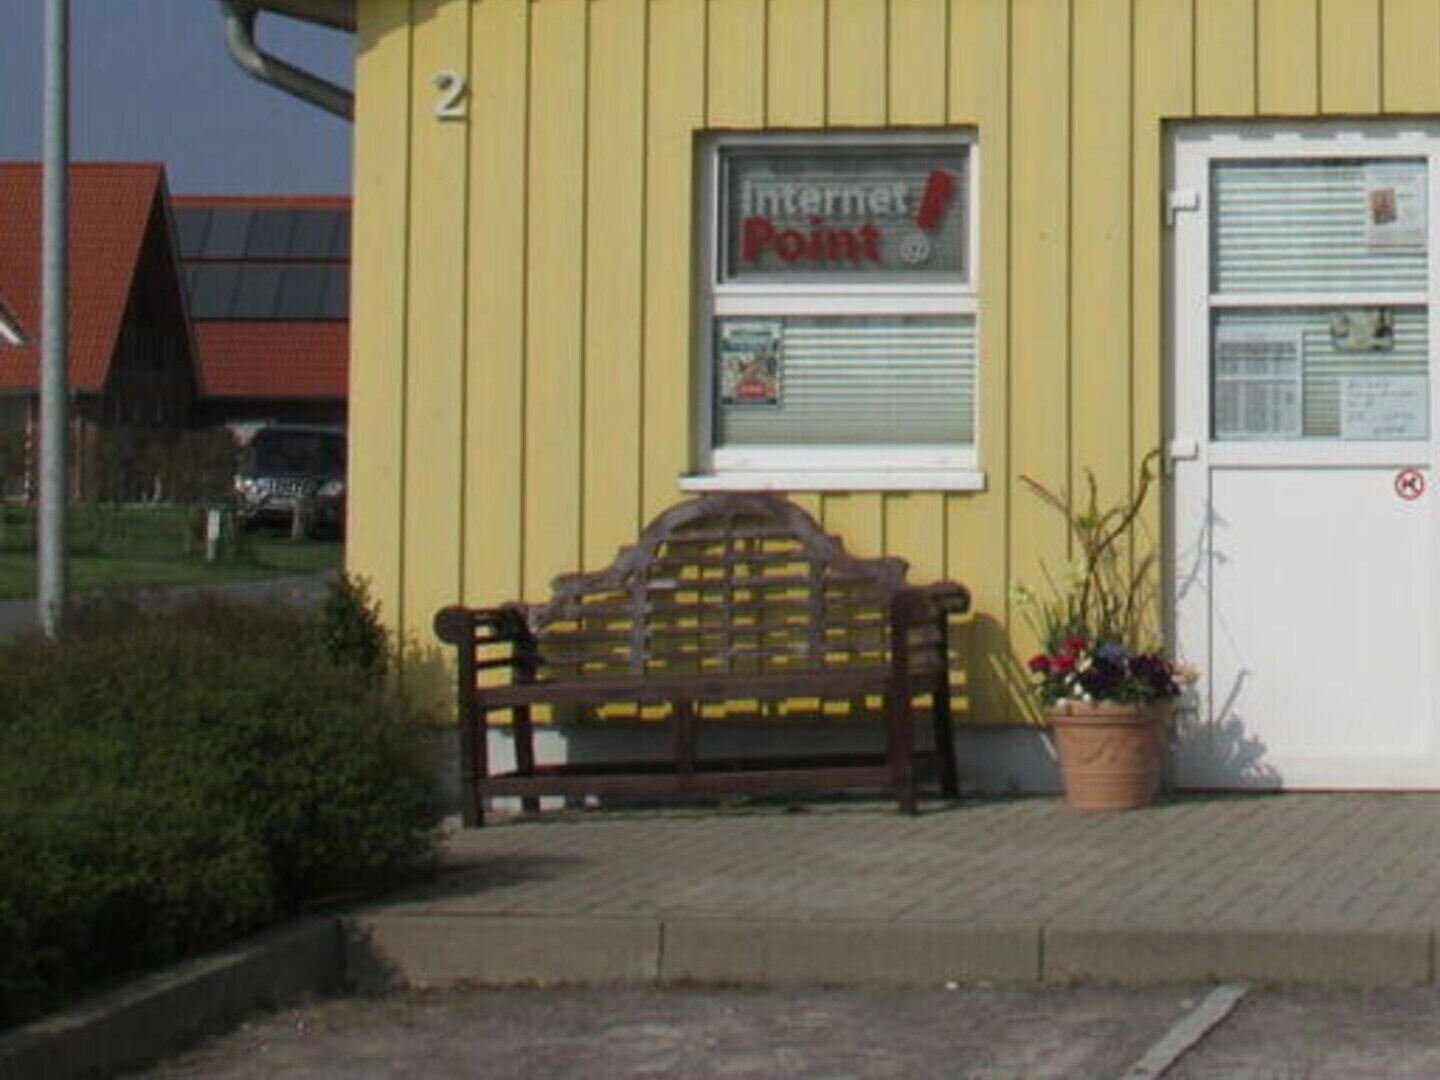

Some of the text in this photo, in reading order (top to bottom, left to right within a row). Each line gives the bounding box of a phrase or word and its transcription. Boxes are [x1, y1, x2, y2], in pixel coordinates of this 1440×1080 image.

[432, 70, 464, 117] 2
[741, 178, 910, 216] Internet
[742, 216, 883, 263] Point
